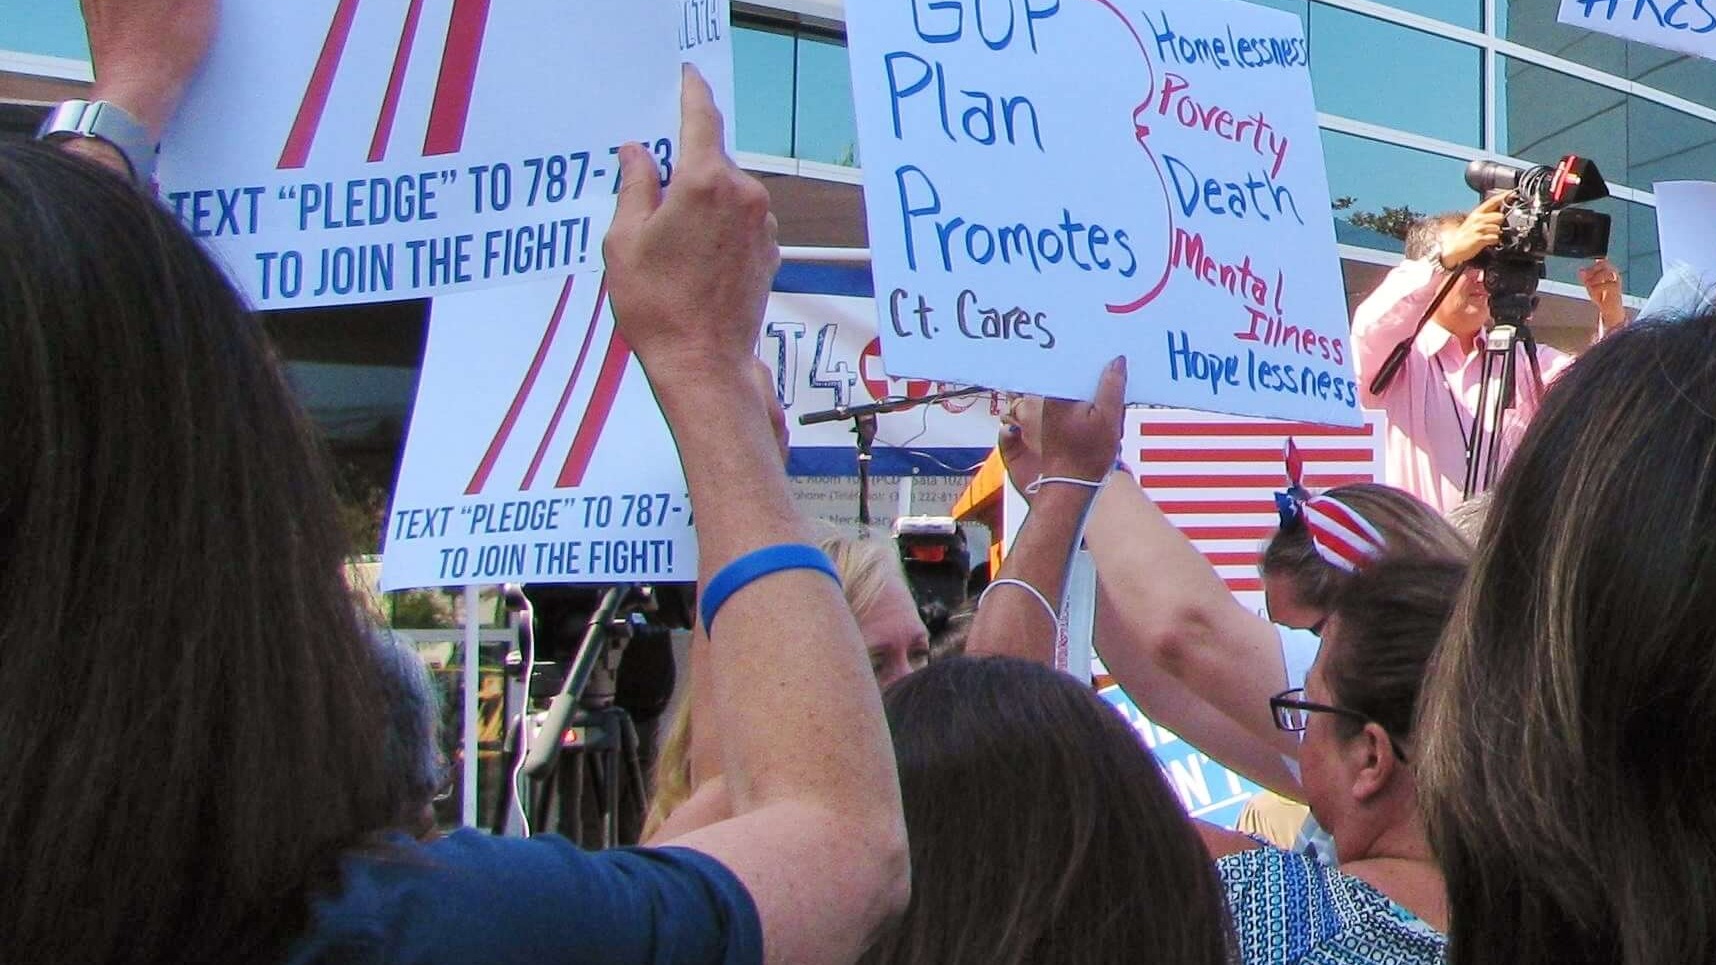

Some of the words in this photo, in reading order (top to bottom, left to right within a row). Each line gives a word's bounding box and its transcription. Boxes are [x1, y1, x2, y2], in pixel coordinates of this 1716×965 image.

[1142, 9, 1309, 70] Homelessness
[883, 51, 1045, 153] Plan
[1158, 72, 1288, 179] Poverty
[168, 186, 266, 237] TEXT
[468, 162, 512, 214] TO
[894, 164, 1137, 278] Promotes
[1162, 153, 1305, 226] Death
[256, 249, 300, 300] TO
[313, 243, 394, 297] JOIN
[406, 235, 473, 289] THE
[483, 217, 591, 278] FIGHT!
[1172, 227, 1284, 316] Mental
[957, 289, 1056, 349] Cares
[1233, 305, 1343, 366] Illness
[1166, 329, 1358, 408] Hopelessness
[394, 506, 455, 541] TEXT
[582, 495, 612, 529] TO
[438, 546, 469, 579] TO
[472, 543, 527, 578] JOIN
[533, 541, 580, 576] THE
[588, 539, 674, 575] FIGHT!
